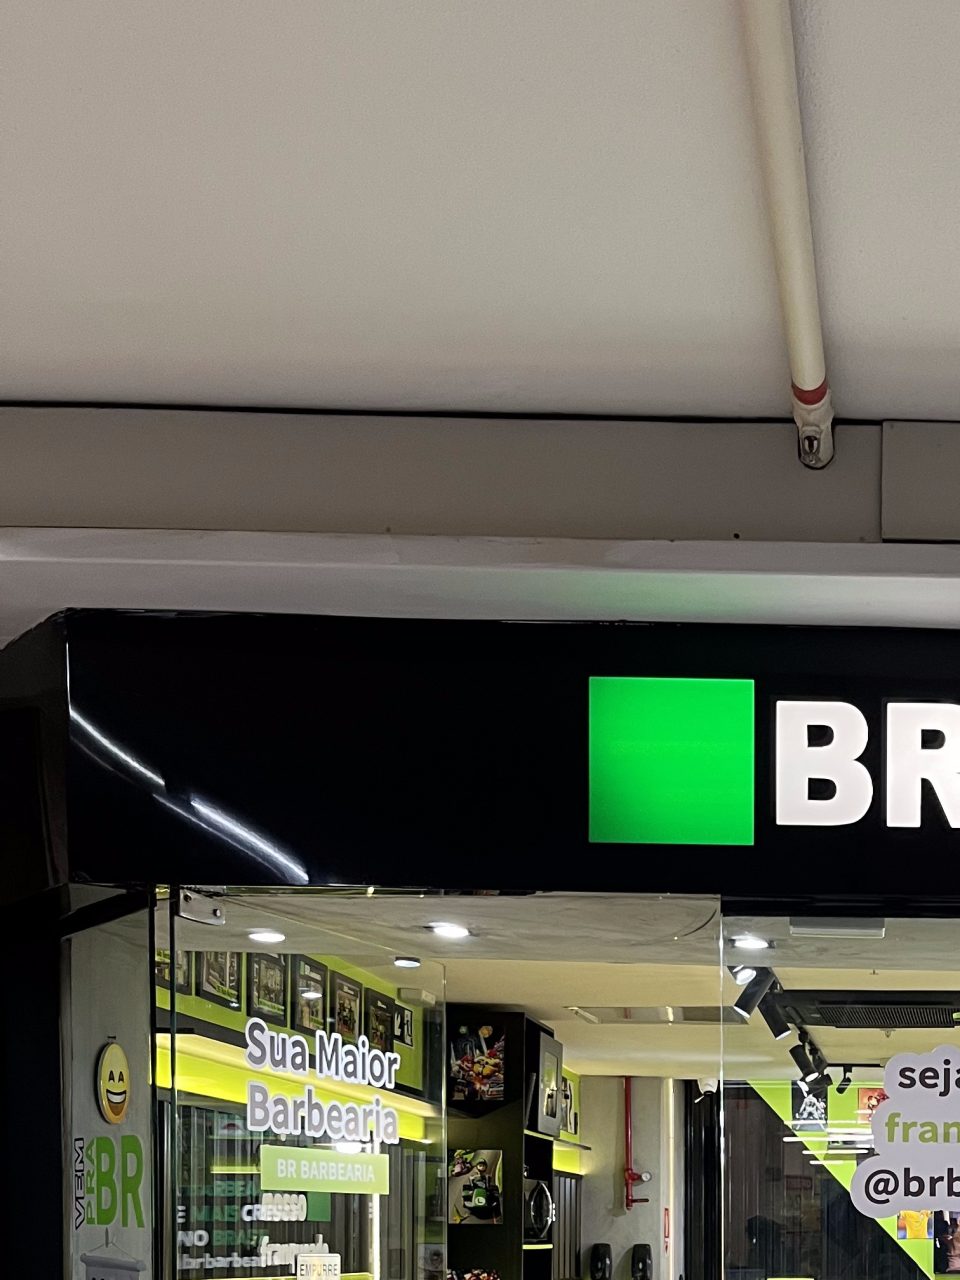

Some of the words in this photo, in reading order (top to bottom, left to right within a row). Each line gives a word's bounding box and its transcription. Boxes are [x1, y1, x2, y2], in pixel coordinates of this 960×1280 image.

[246, 1019, 308, 1073] Sua
[317, 1033, 399, 1086] Maior
[248, 1083, 399, 1142] Barbearia
[74, 1137, 86, 1231] VEM
[85, 1137, 96, 1226] PRA
[96, 1134, 145, 1229] BR
[277, 1158, 297, 1178] BR
[300, 1160, 376, 1183] BARBEARIA
[300, 1263, 338, 1277] EMPURRE
